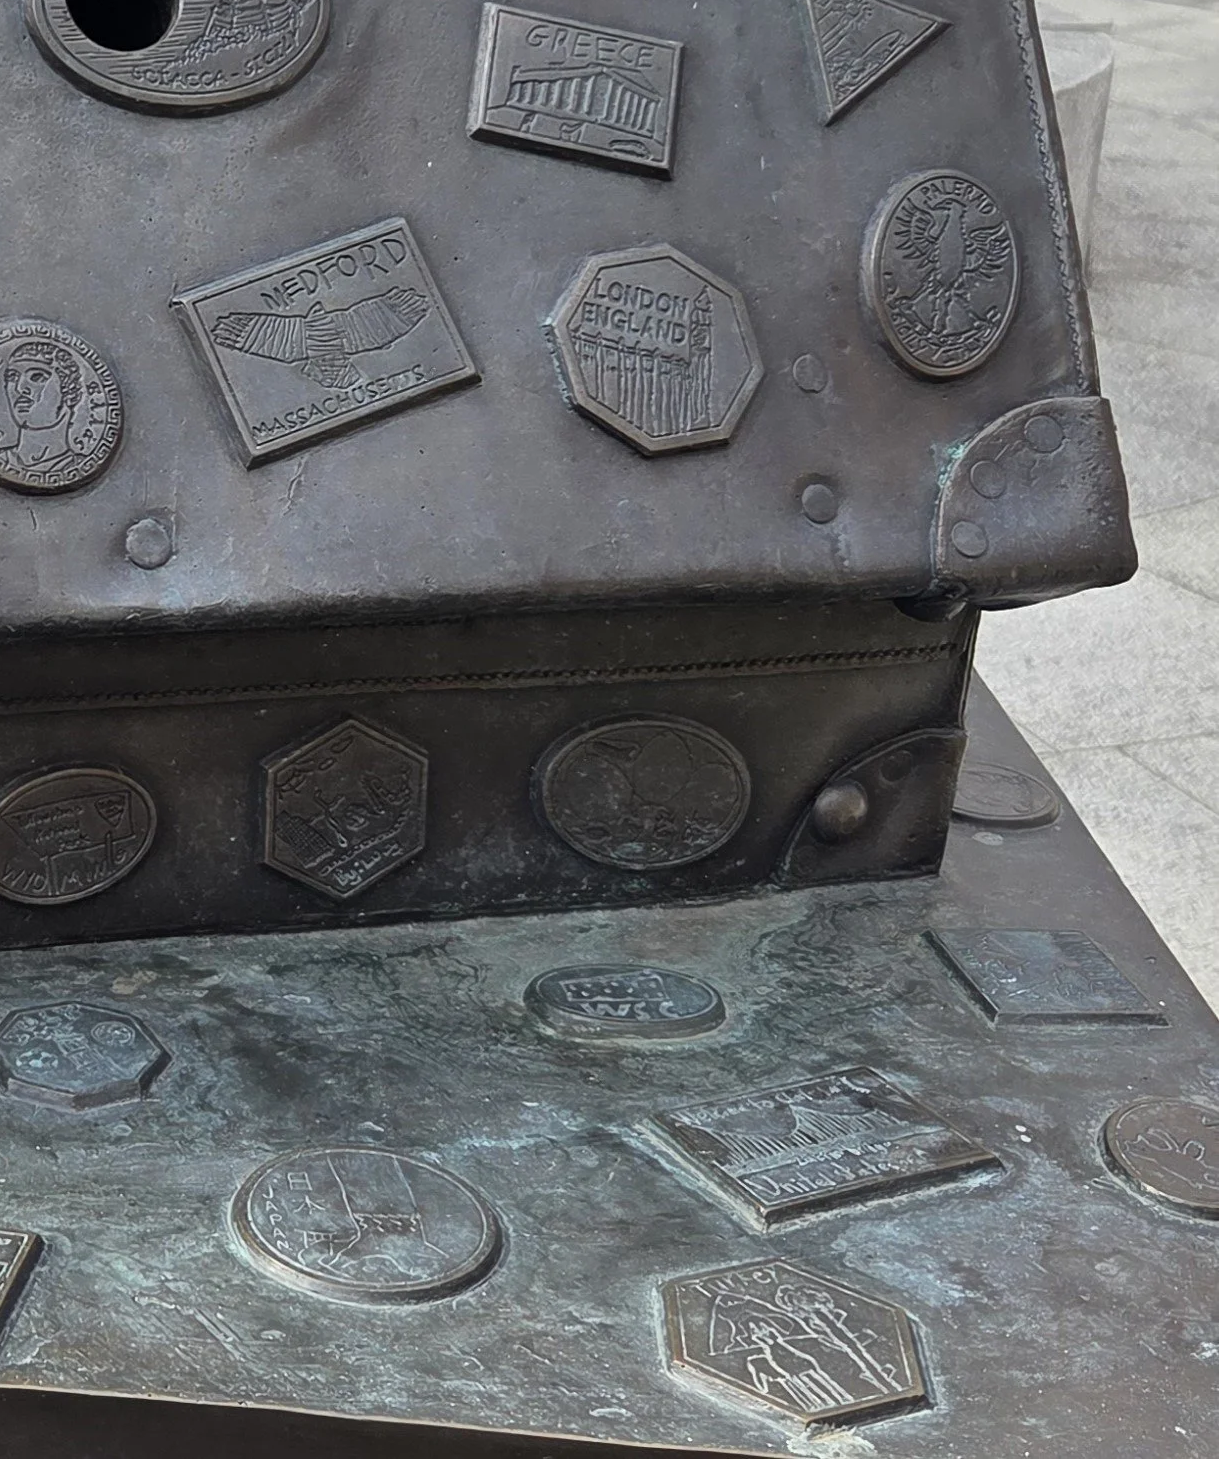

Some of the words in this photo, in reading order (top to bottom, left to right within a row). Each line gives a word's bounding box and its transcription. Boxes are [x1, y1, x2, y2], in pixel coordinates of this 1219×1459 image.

[526, 24, 655, 68] GREECE
[260, 237, 408, 311] MEDFORD
[593, 277, 690, 317] LONDON
[581, 300, 687, 345] ENGLAND
[250, 363, 426, 440] MASSACHUSETTS
[744, 1170, 837, 1196] United
[262, 1184, 293, 1252] JAPAN
